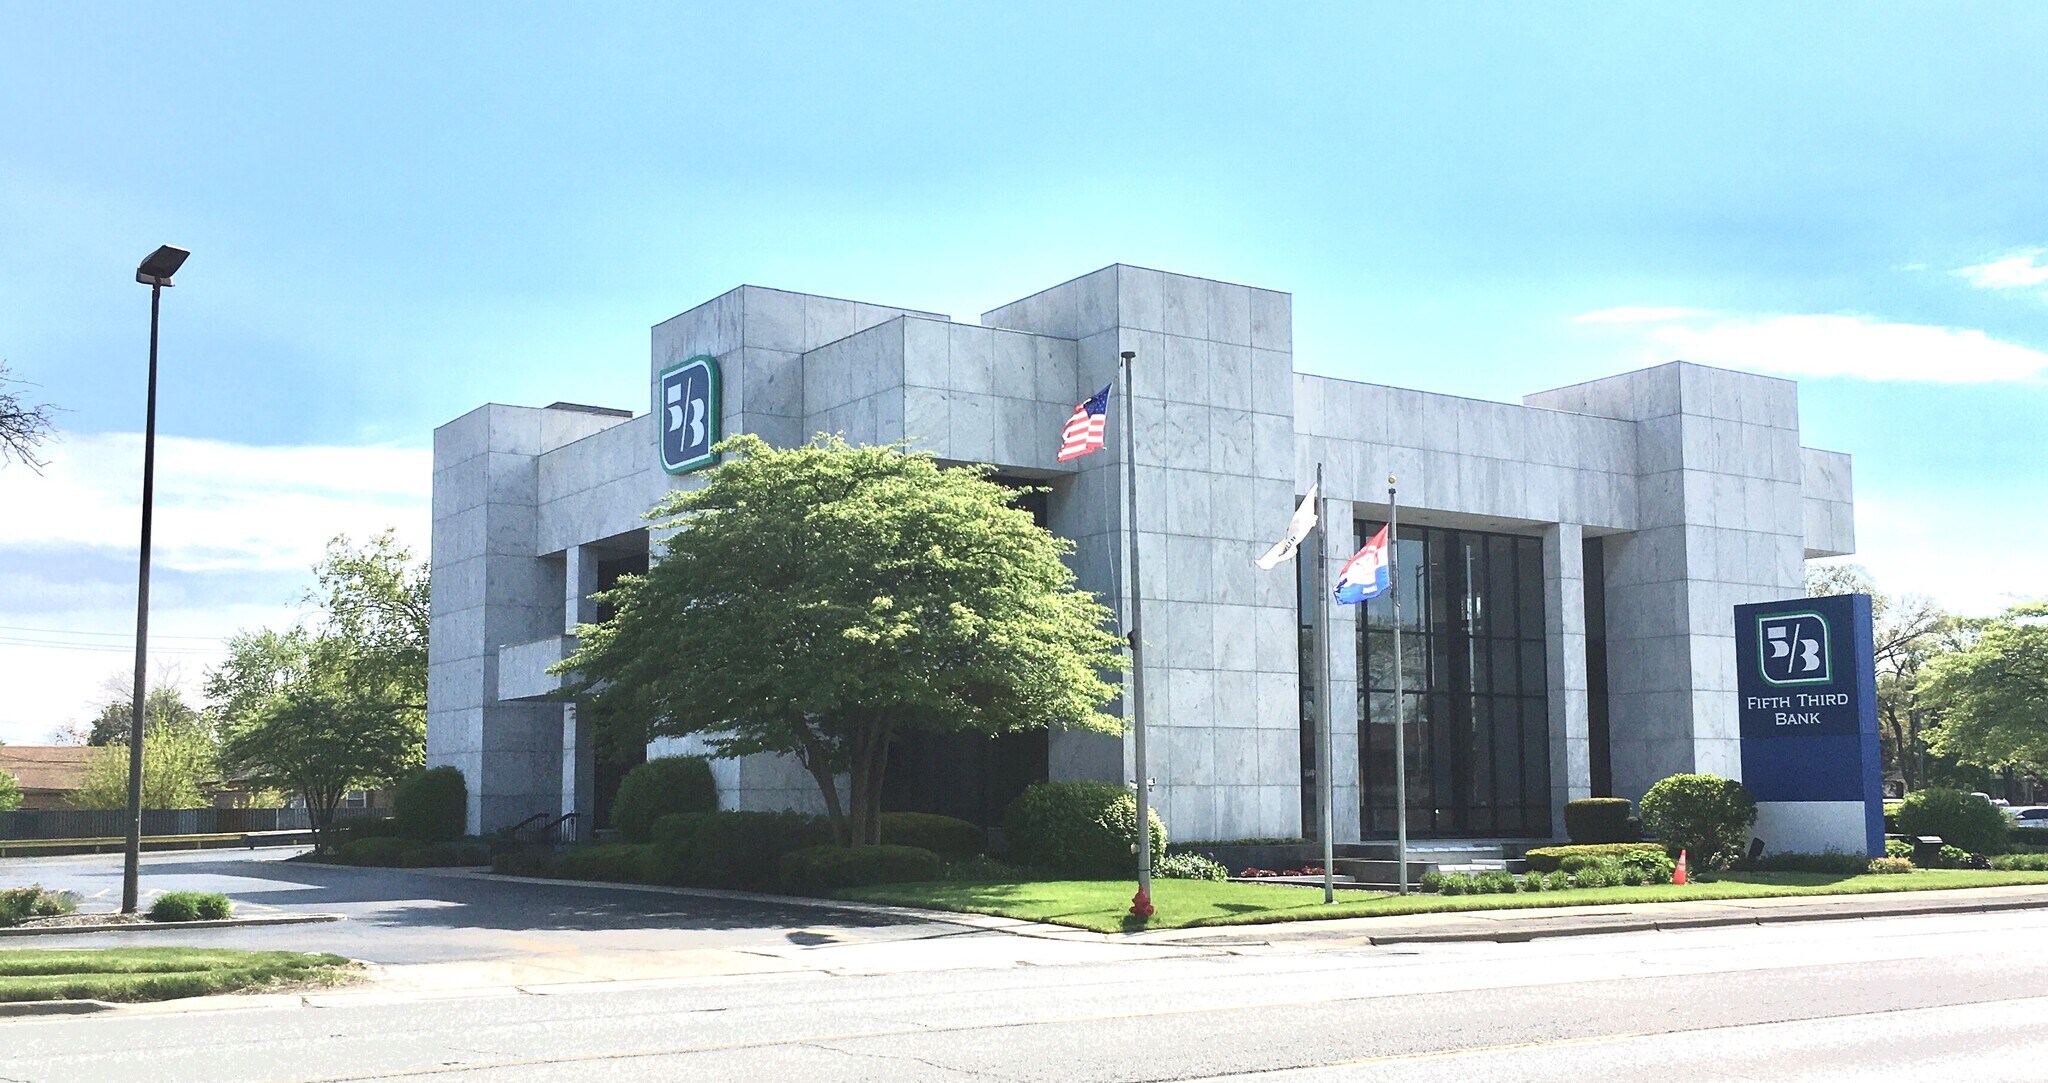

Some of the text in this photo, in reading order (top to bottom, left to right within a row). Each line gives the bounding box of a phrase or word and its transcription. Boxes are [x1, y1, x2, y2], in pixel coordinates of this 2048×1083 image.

[1747, 693, 1849, 710] FIFTH THIRD
[1775, 712, 1821, 726] BANK
